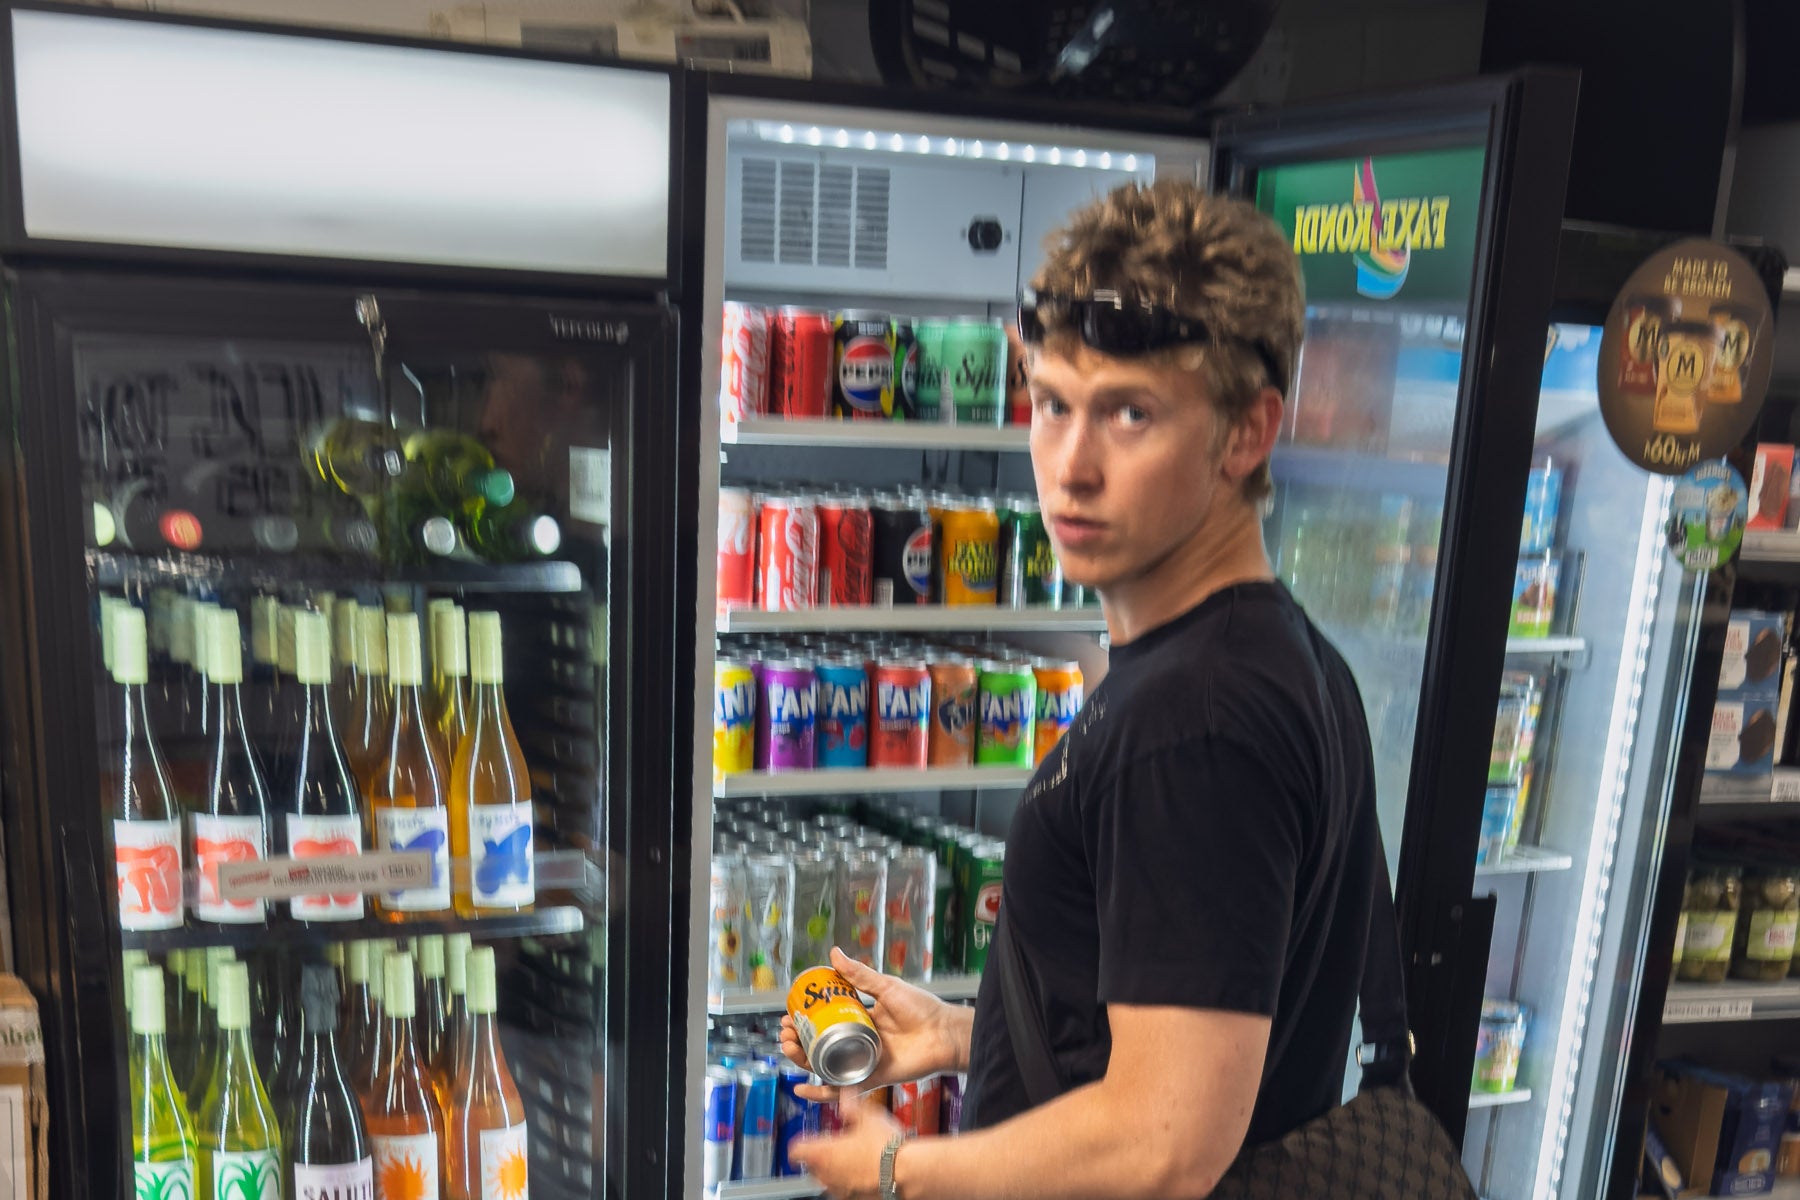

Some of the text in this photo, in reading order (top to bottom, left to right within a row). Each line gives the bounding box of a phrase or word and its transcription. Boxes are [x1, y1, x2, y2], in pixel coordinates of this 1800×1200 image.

[1672, 257, 1728, 281] MADE TO
[1676, 352, 1696, 379] M
